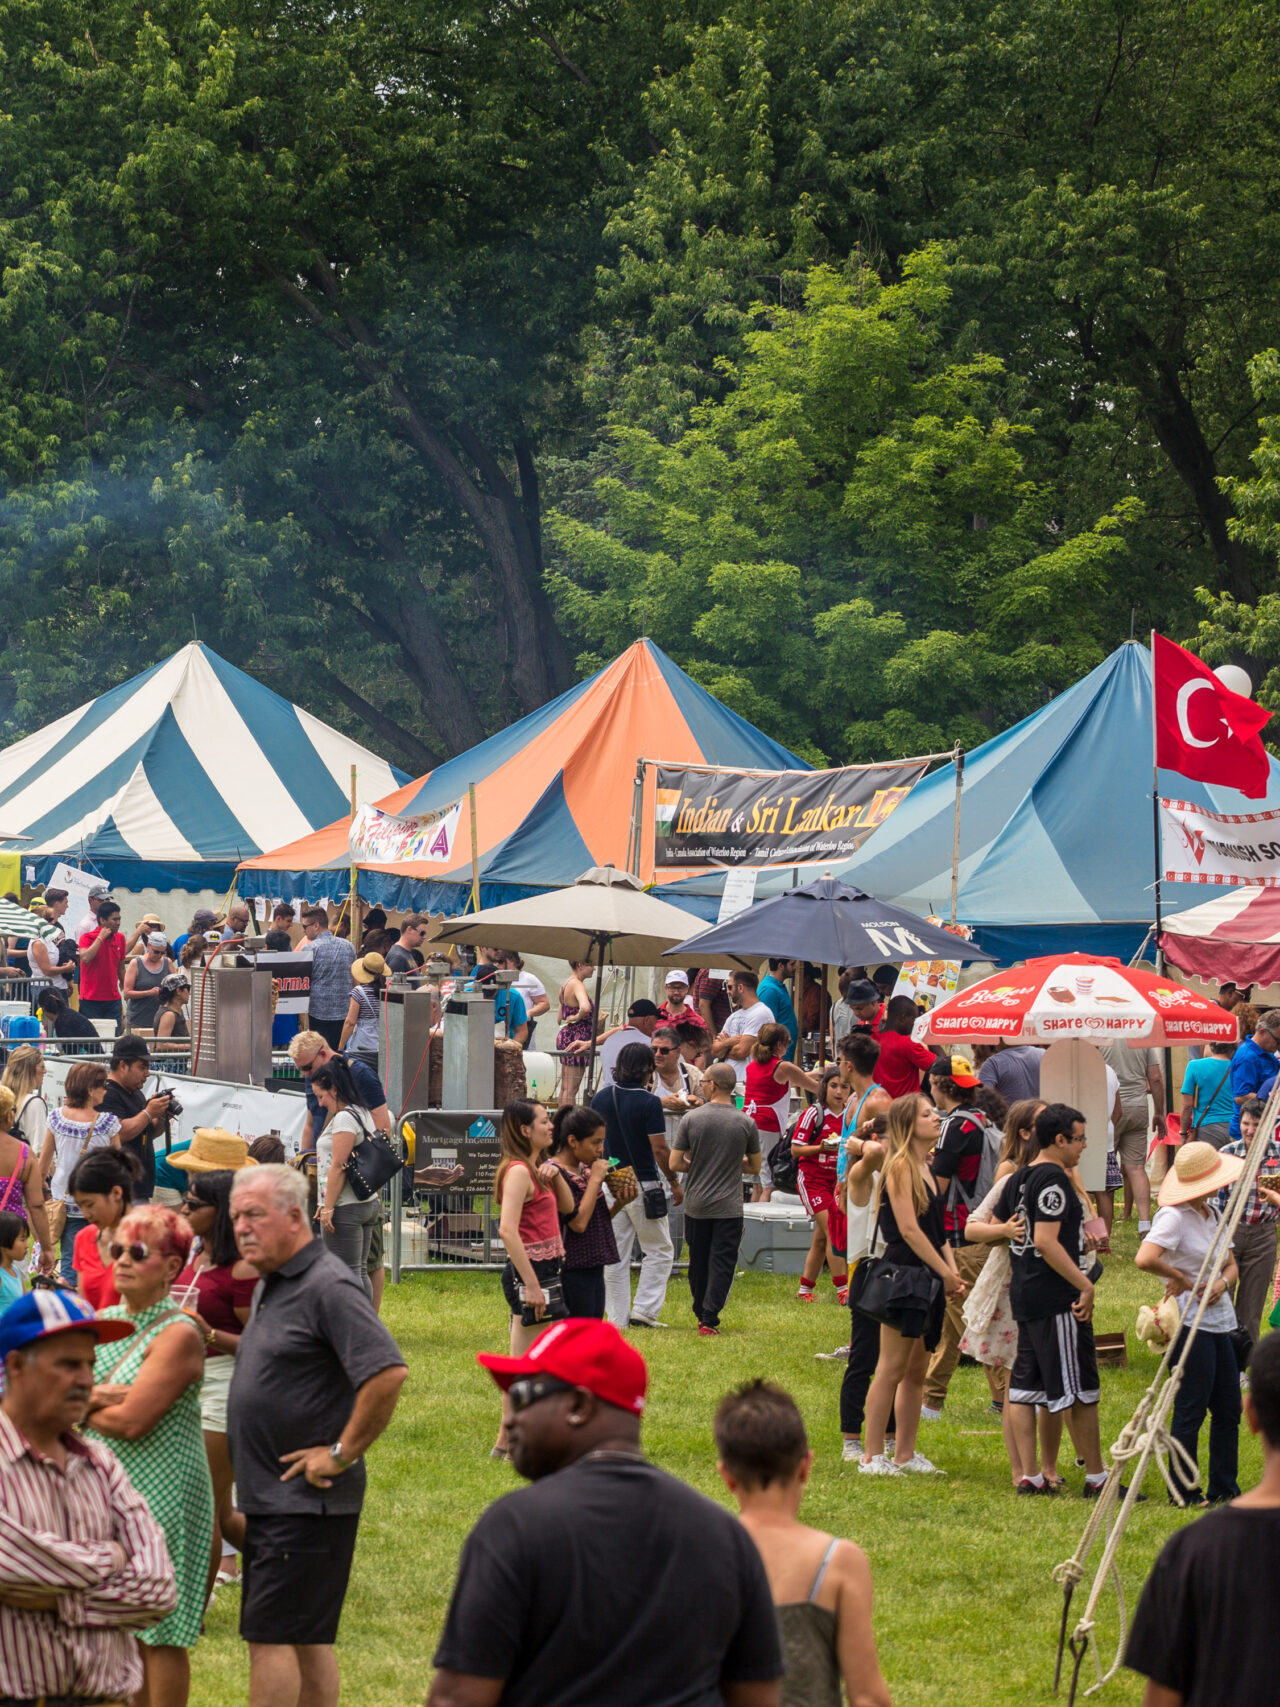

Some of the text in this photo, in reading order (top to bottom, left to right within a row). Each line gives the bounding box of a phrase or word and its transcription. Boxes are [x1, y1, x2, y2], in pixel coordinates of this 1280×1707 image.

[676, 796, 734, 833] Indian
[730, 811, 745, 833] &
[746, 796, 784, 834] Sri
[730, 848, 746, 860] Region
[422, 1136, 463, 1144] Mortgage
[811, 1195, 823, 1207] 13
